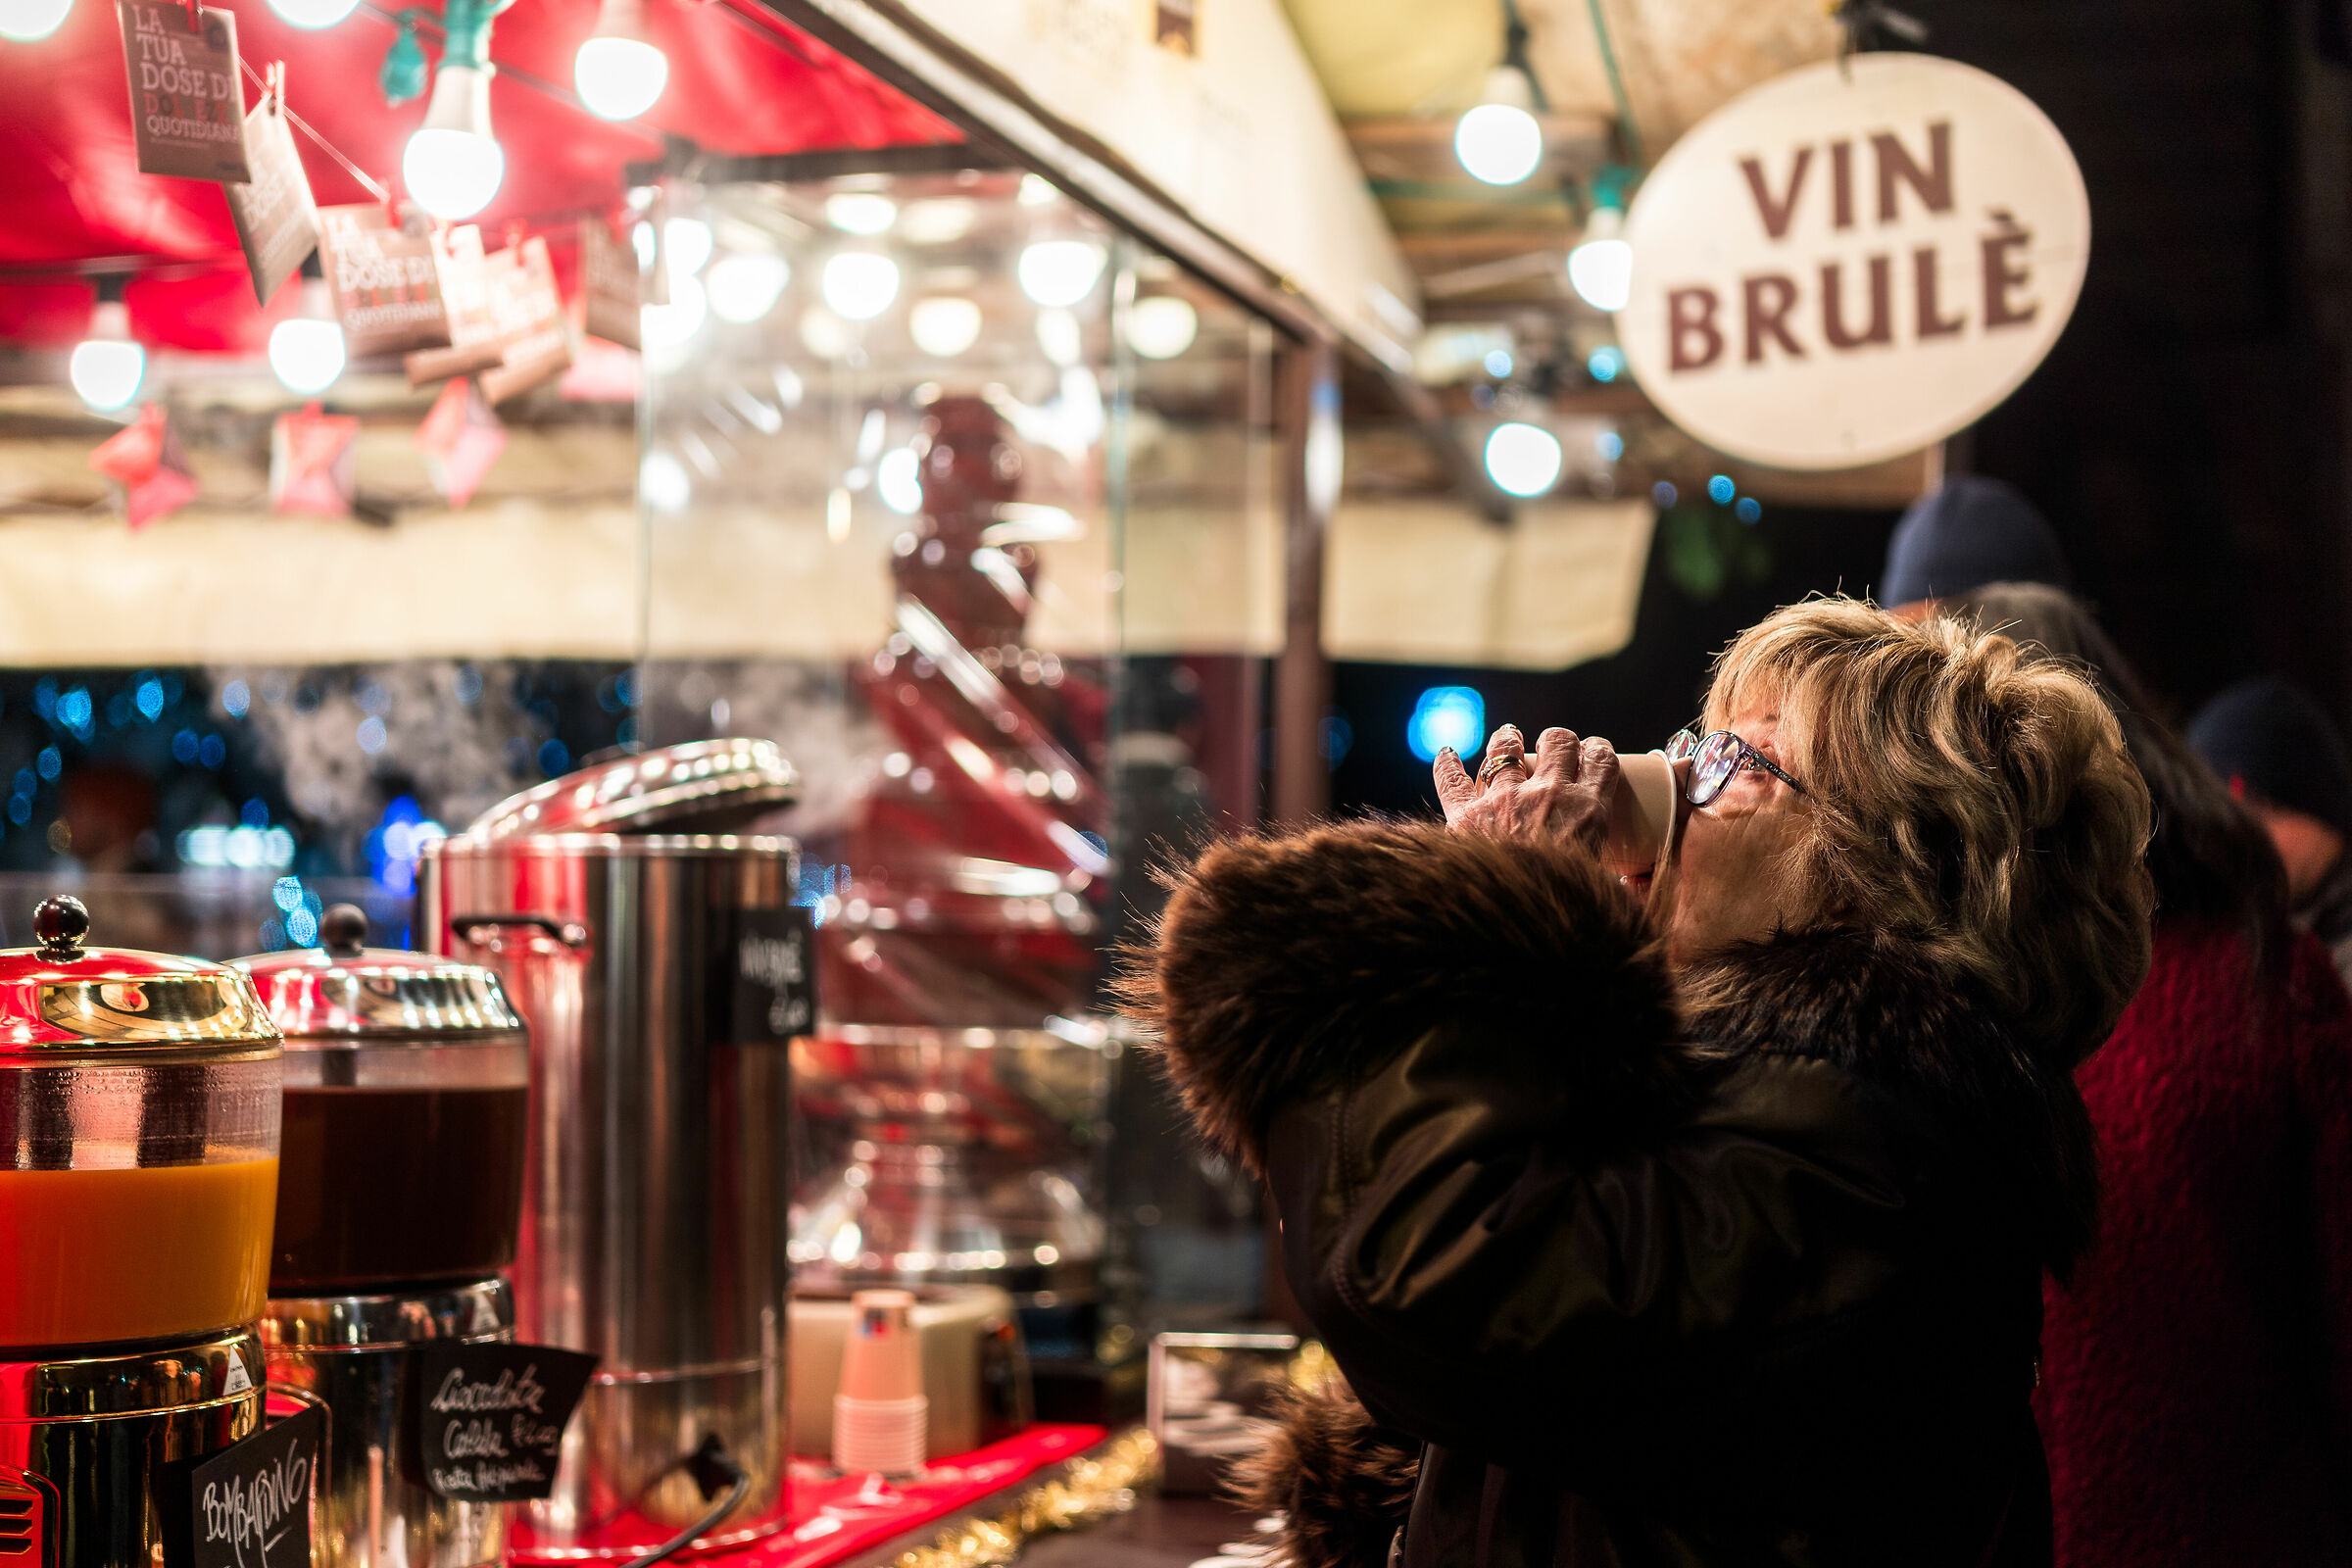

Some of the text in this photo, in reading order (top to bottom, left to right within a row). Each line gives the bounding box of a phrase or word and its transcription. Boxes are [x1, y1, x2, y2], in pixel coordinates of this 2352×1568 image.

[131, 4, 166, 34] LA
[135, 33, 187, 66] TUA
[139, 61, 207, 98] DOSE
[1737, 120, 1955, 241] VIN
[1666, 208, 2039, 378] BRULÈ
